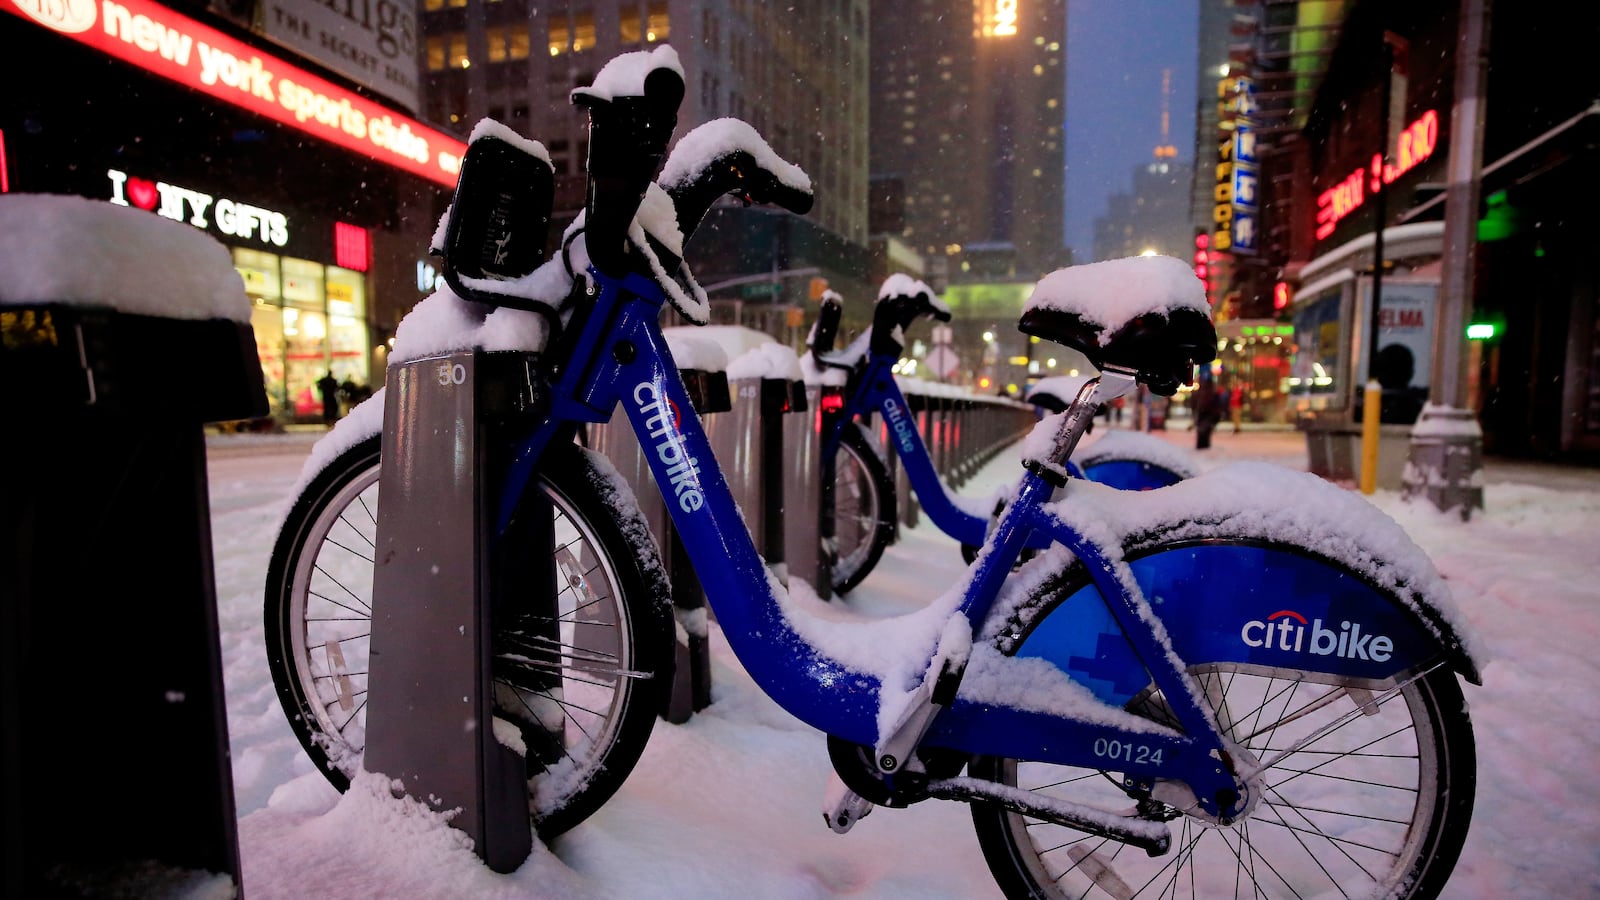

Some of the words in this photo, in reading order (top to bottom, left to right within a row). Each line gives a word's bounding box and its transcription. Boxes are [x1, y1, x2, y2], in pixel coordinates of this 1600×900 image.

[272, 5, 310, 39] THE
[319, 30, 378, 73] SECRET
[102, 0, 192, 67] new
[197, 41, 275, 103] york
[278, 78, 367, 139] sports
[368, 115, 430, 165] clubs
[107, 168, 129, 207] I
[156, 181, 213, 228] NY
[215, 198, 289, 247] GIFTS
[1379, 308, 1424, 328] ELMA
[439, 363, 466, 385] 50
[739, 386, 756, 399] 48
[1241, 616, 1304, 653] citi
[1309, 618, 1394, 662] bike
[1094, 737, 1164, 767] 00124
